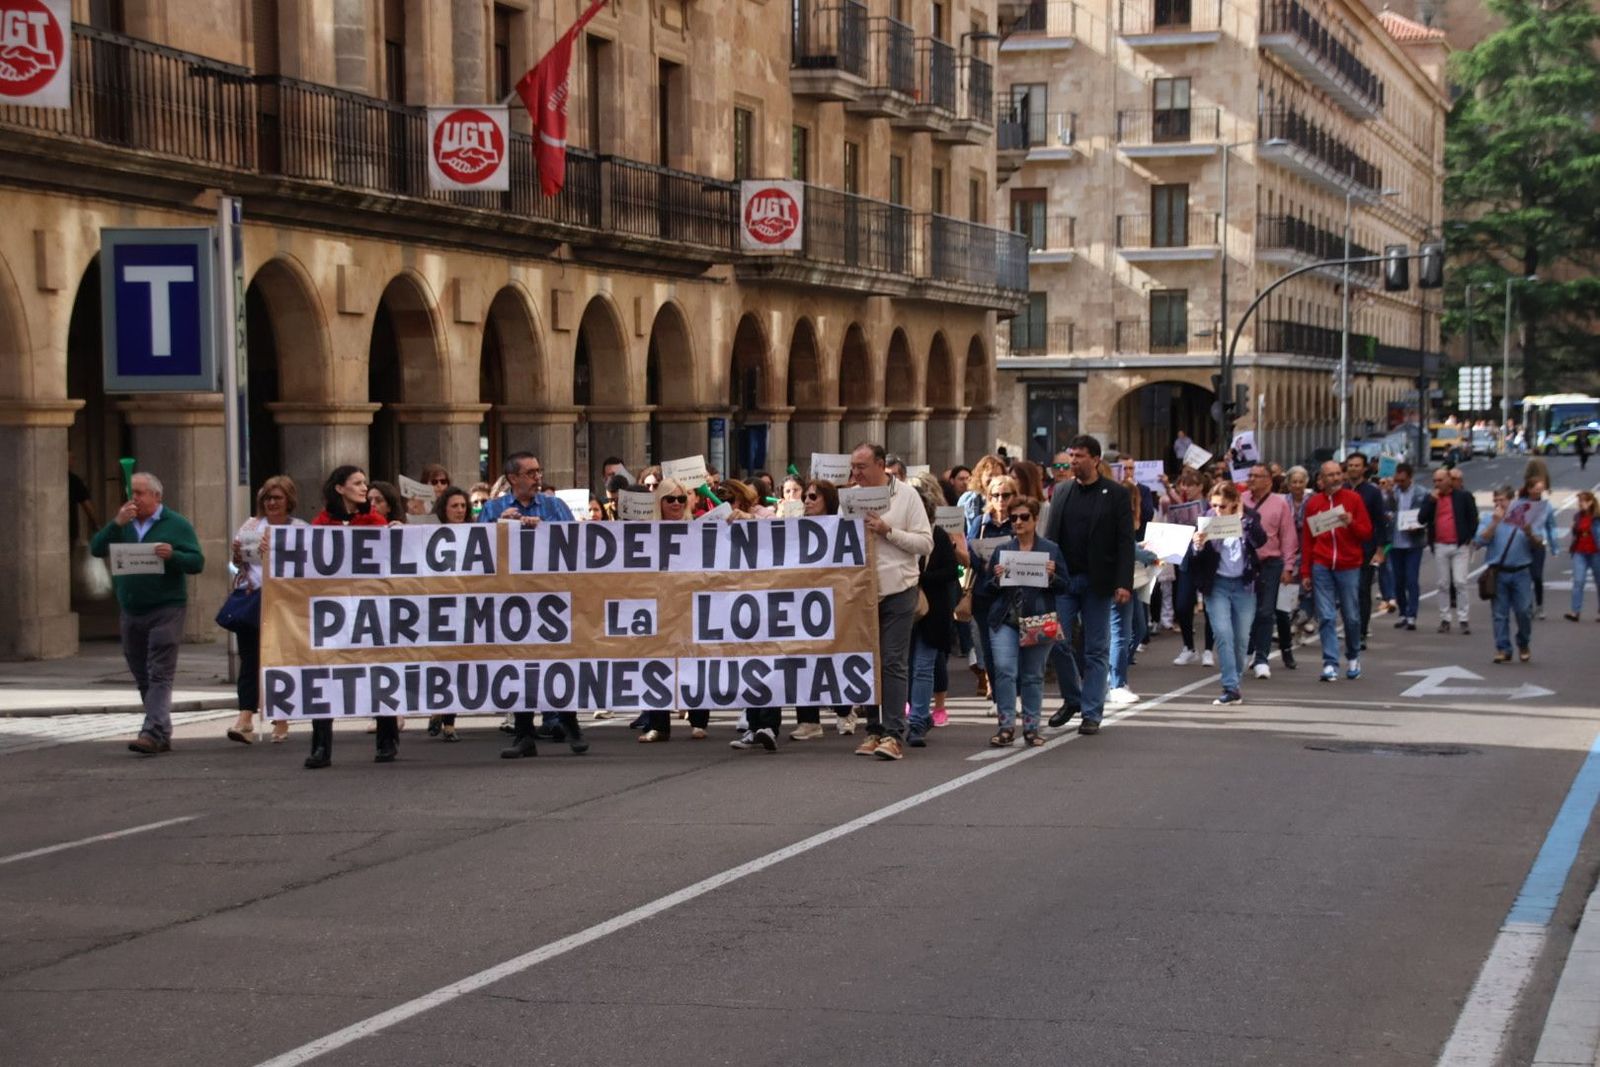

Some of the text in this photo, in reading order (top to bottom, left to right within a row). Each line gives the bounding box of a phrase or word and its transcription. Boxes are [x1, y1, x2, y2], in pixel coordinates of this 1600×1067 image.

[0, 10, 50, 52] GT
[441, 122, 493, 152] UGT
[752, 197, 792, 221] UGT
[123, 265, 195, 356] T
[273, 527, 496, 578] HUELGA
[313, 591, 832, 647] PAREMOS La LOEO
[681, 655, 872, 709] JUSTAS
